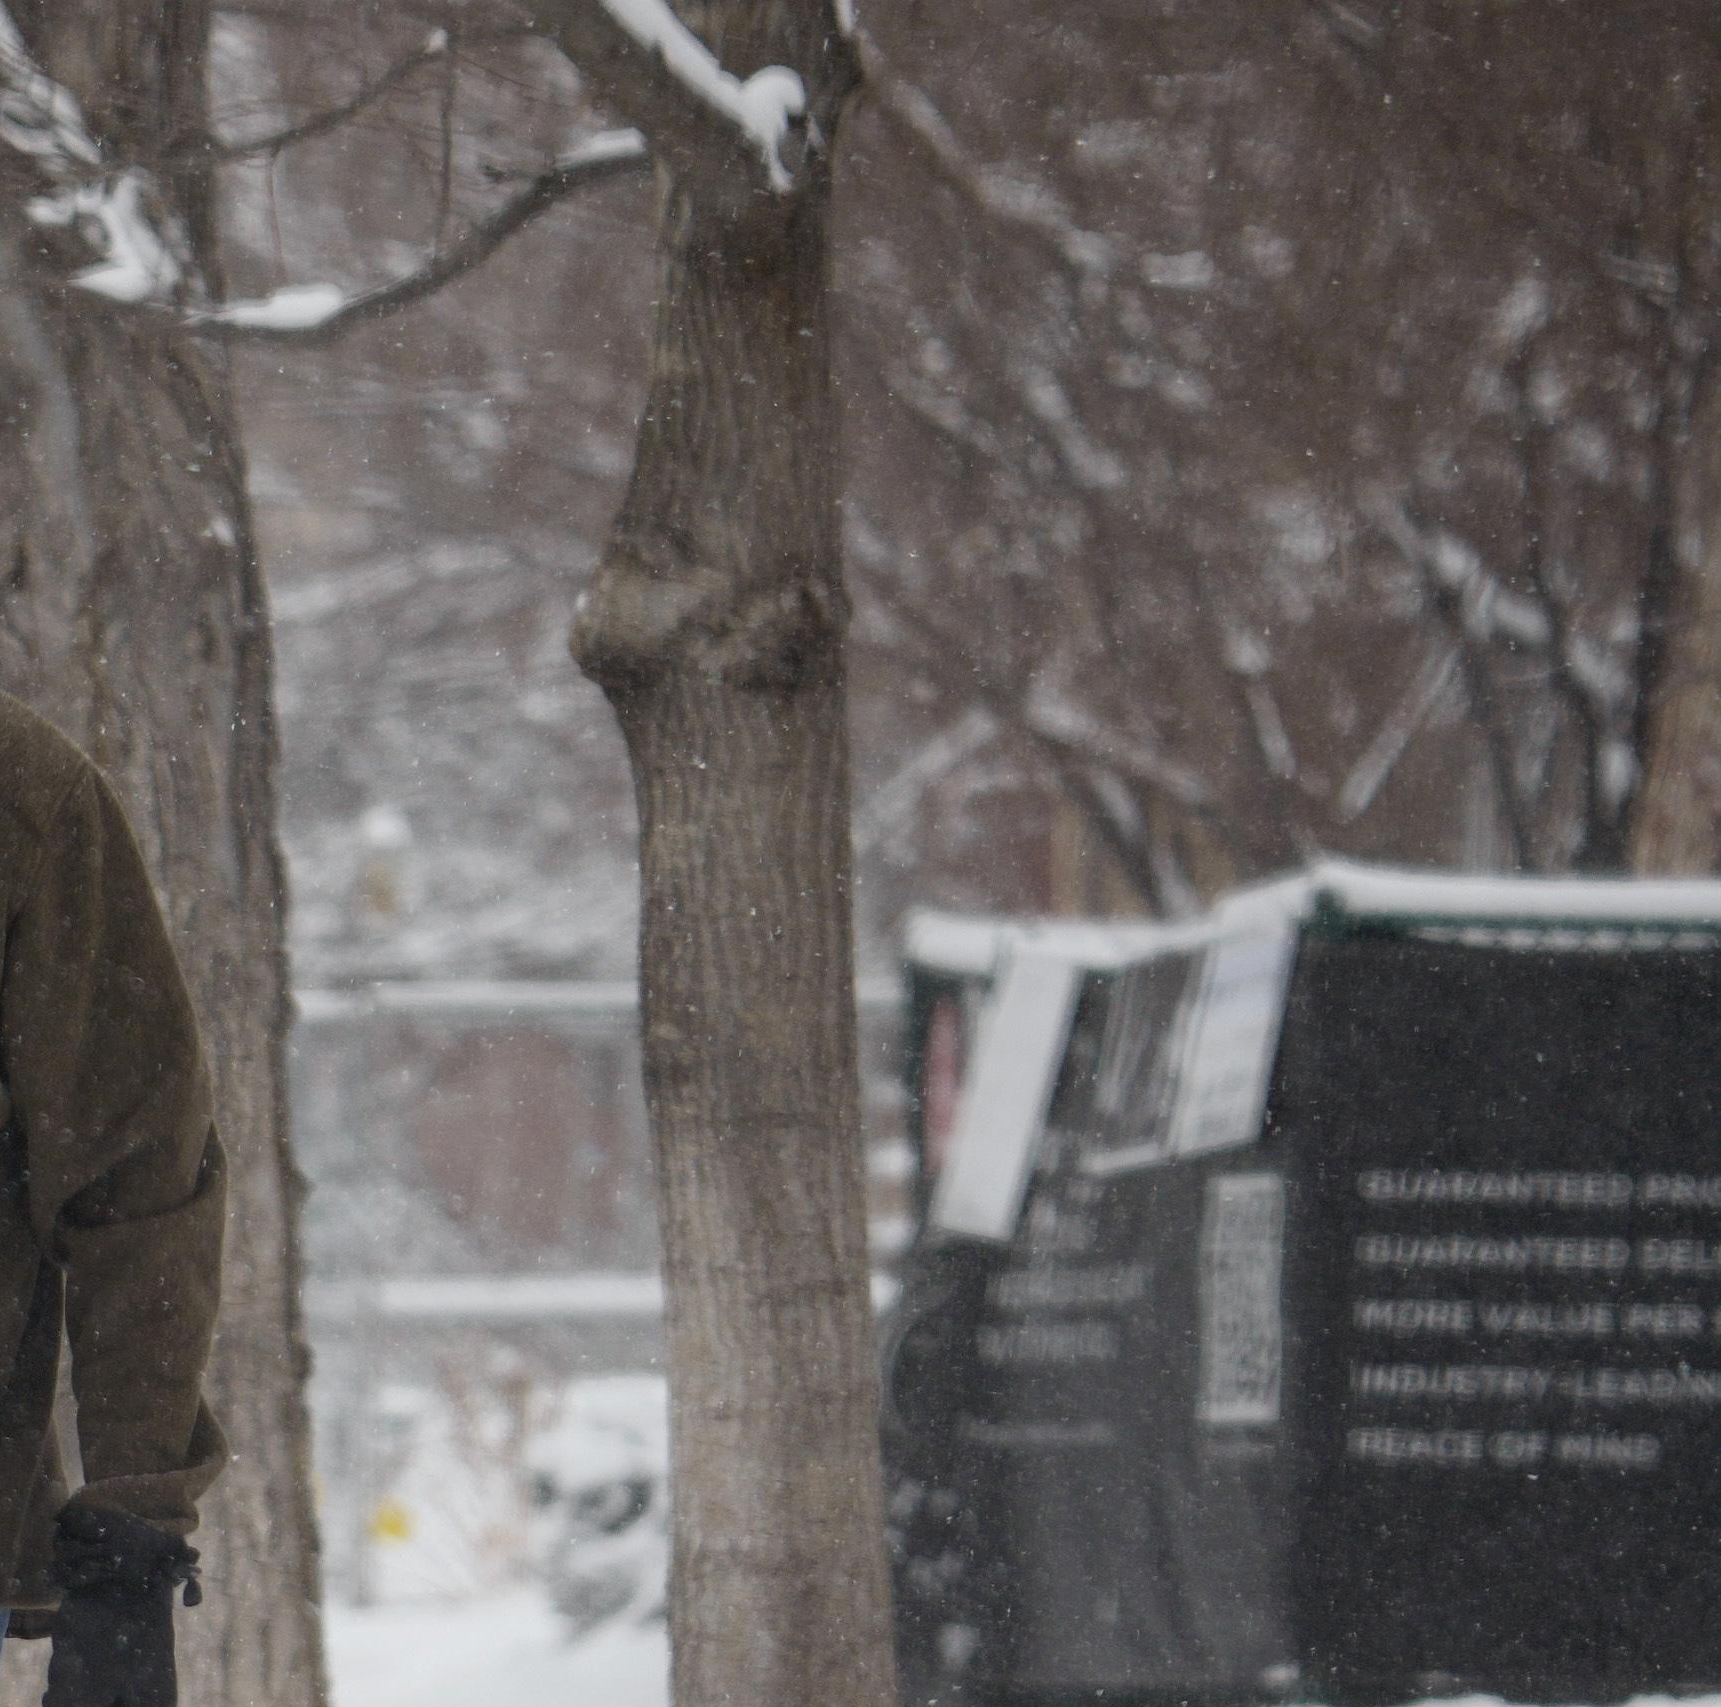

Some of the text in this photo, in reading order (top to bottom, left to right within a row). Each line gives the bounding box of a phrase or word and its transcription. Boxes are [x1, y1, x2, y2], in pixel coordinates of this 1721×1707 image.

[1357, 1169, 1634, 1204] GUARANTEED
[1355, 1235, 1631, 1270] GUARANTEED
[1479, 1302, 1615, 1334] VALUE
